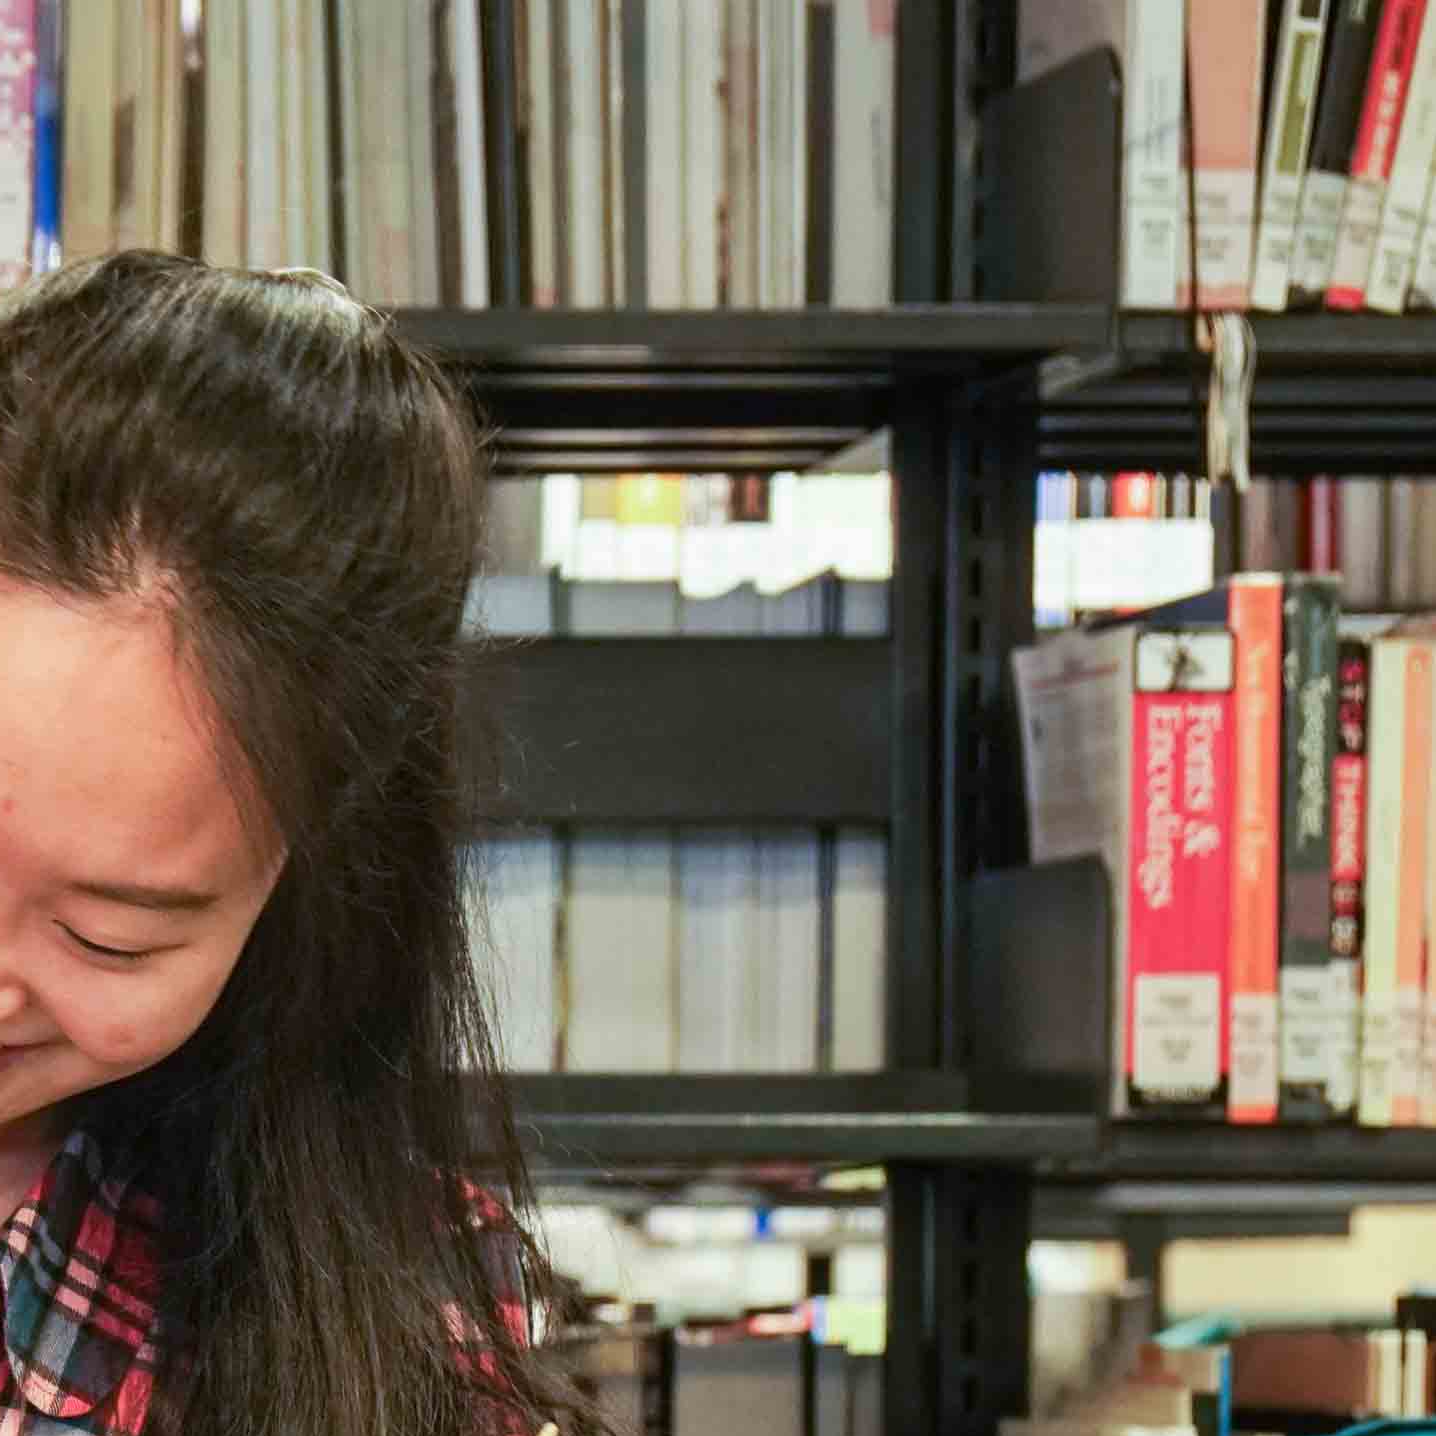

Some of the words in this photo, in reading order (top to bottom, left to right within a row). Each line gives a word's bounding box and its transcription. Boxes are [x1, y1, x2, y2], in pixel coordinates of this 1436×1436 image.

[1138, 704, 1184, 910] Encodings
[1185, 702, 1222, 812] Fonts
[1183, 820, 1221, 859] &
[1333, 762, 1360, 873] THINK
